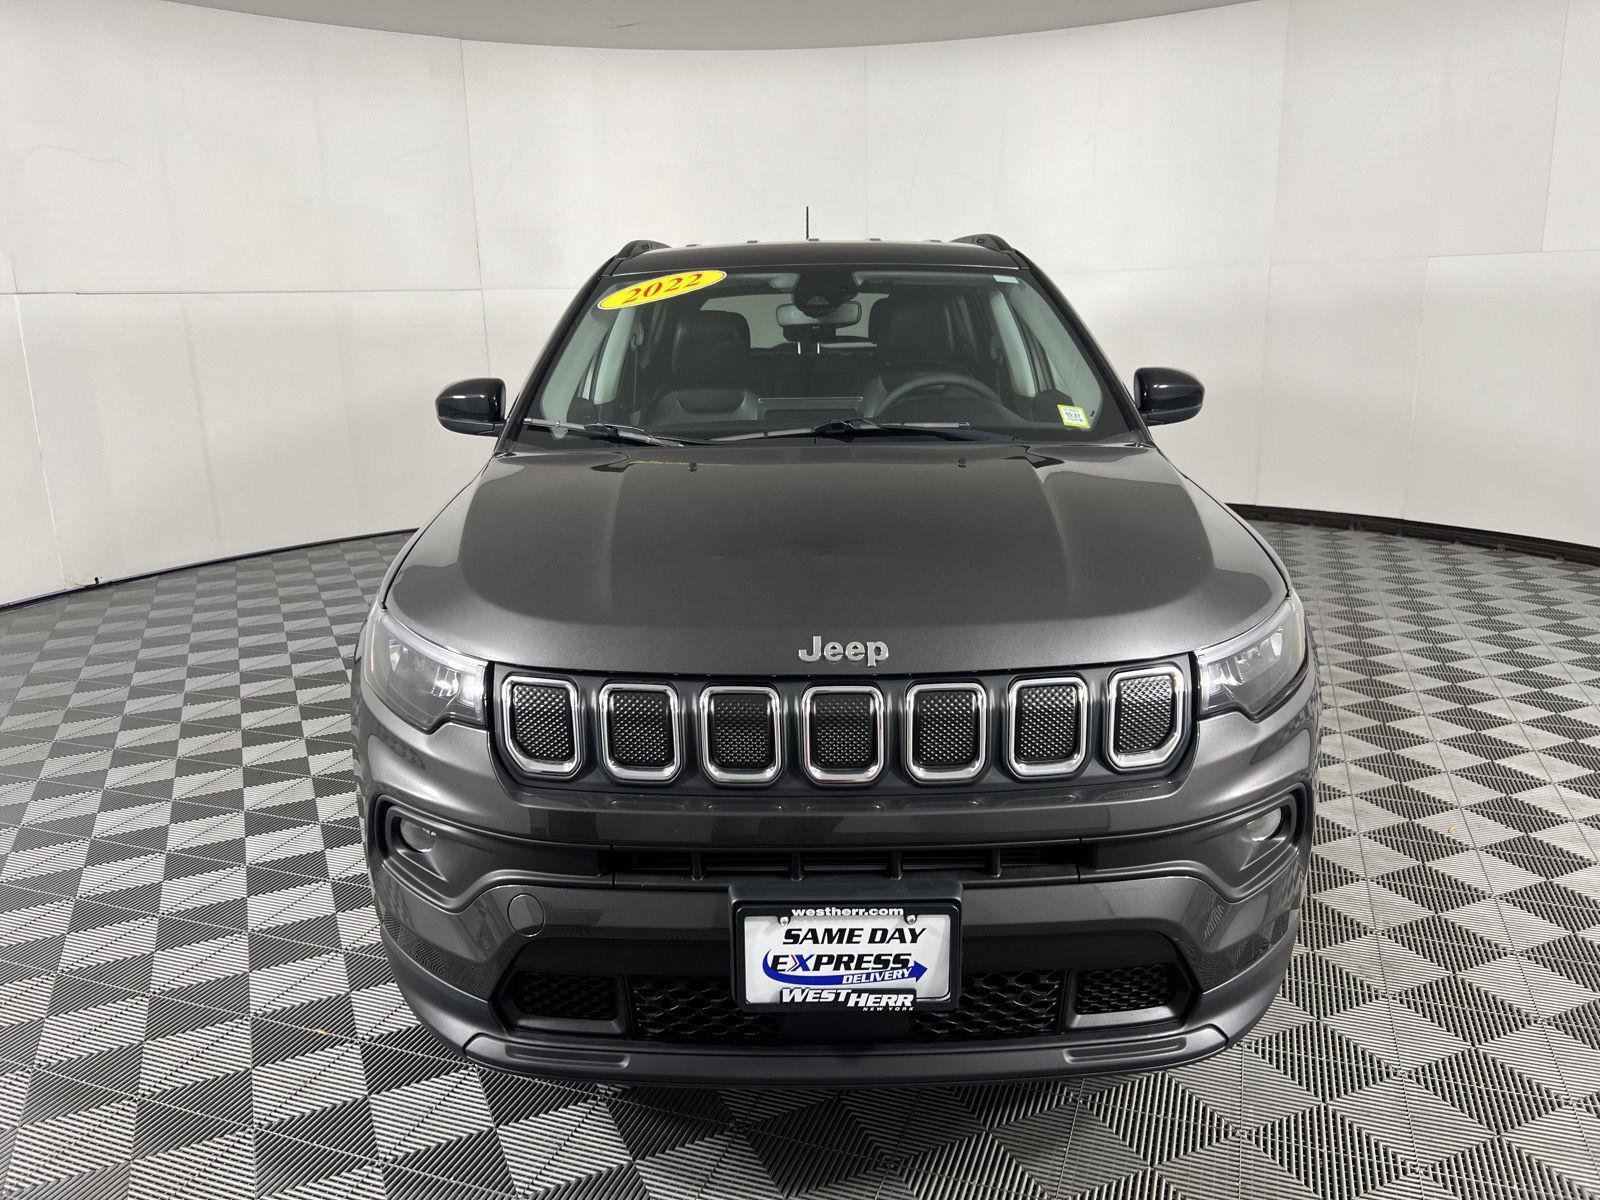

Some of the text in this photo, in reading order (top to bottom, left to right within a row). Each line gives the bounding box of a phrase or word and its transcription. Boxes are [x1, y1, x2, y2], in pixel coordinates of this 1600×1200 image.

[621, 273, 703, 306] 2022
[798, 635, 889, 667] Jeep
[791, 907, 904, 917] westherr.com
[783, 928, 927, 945] SAME DAY
[770, 953, 912, 972] EXPRESS
[842, 967, 914, 985] DELIVERY
